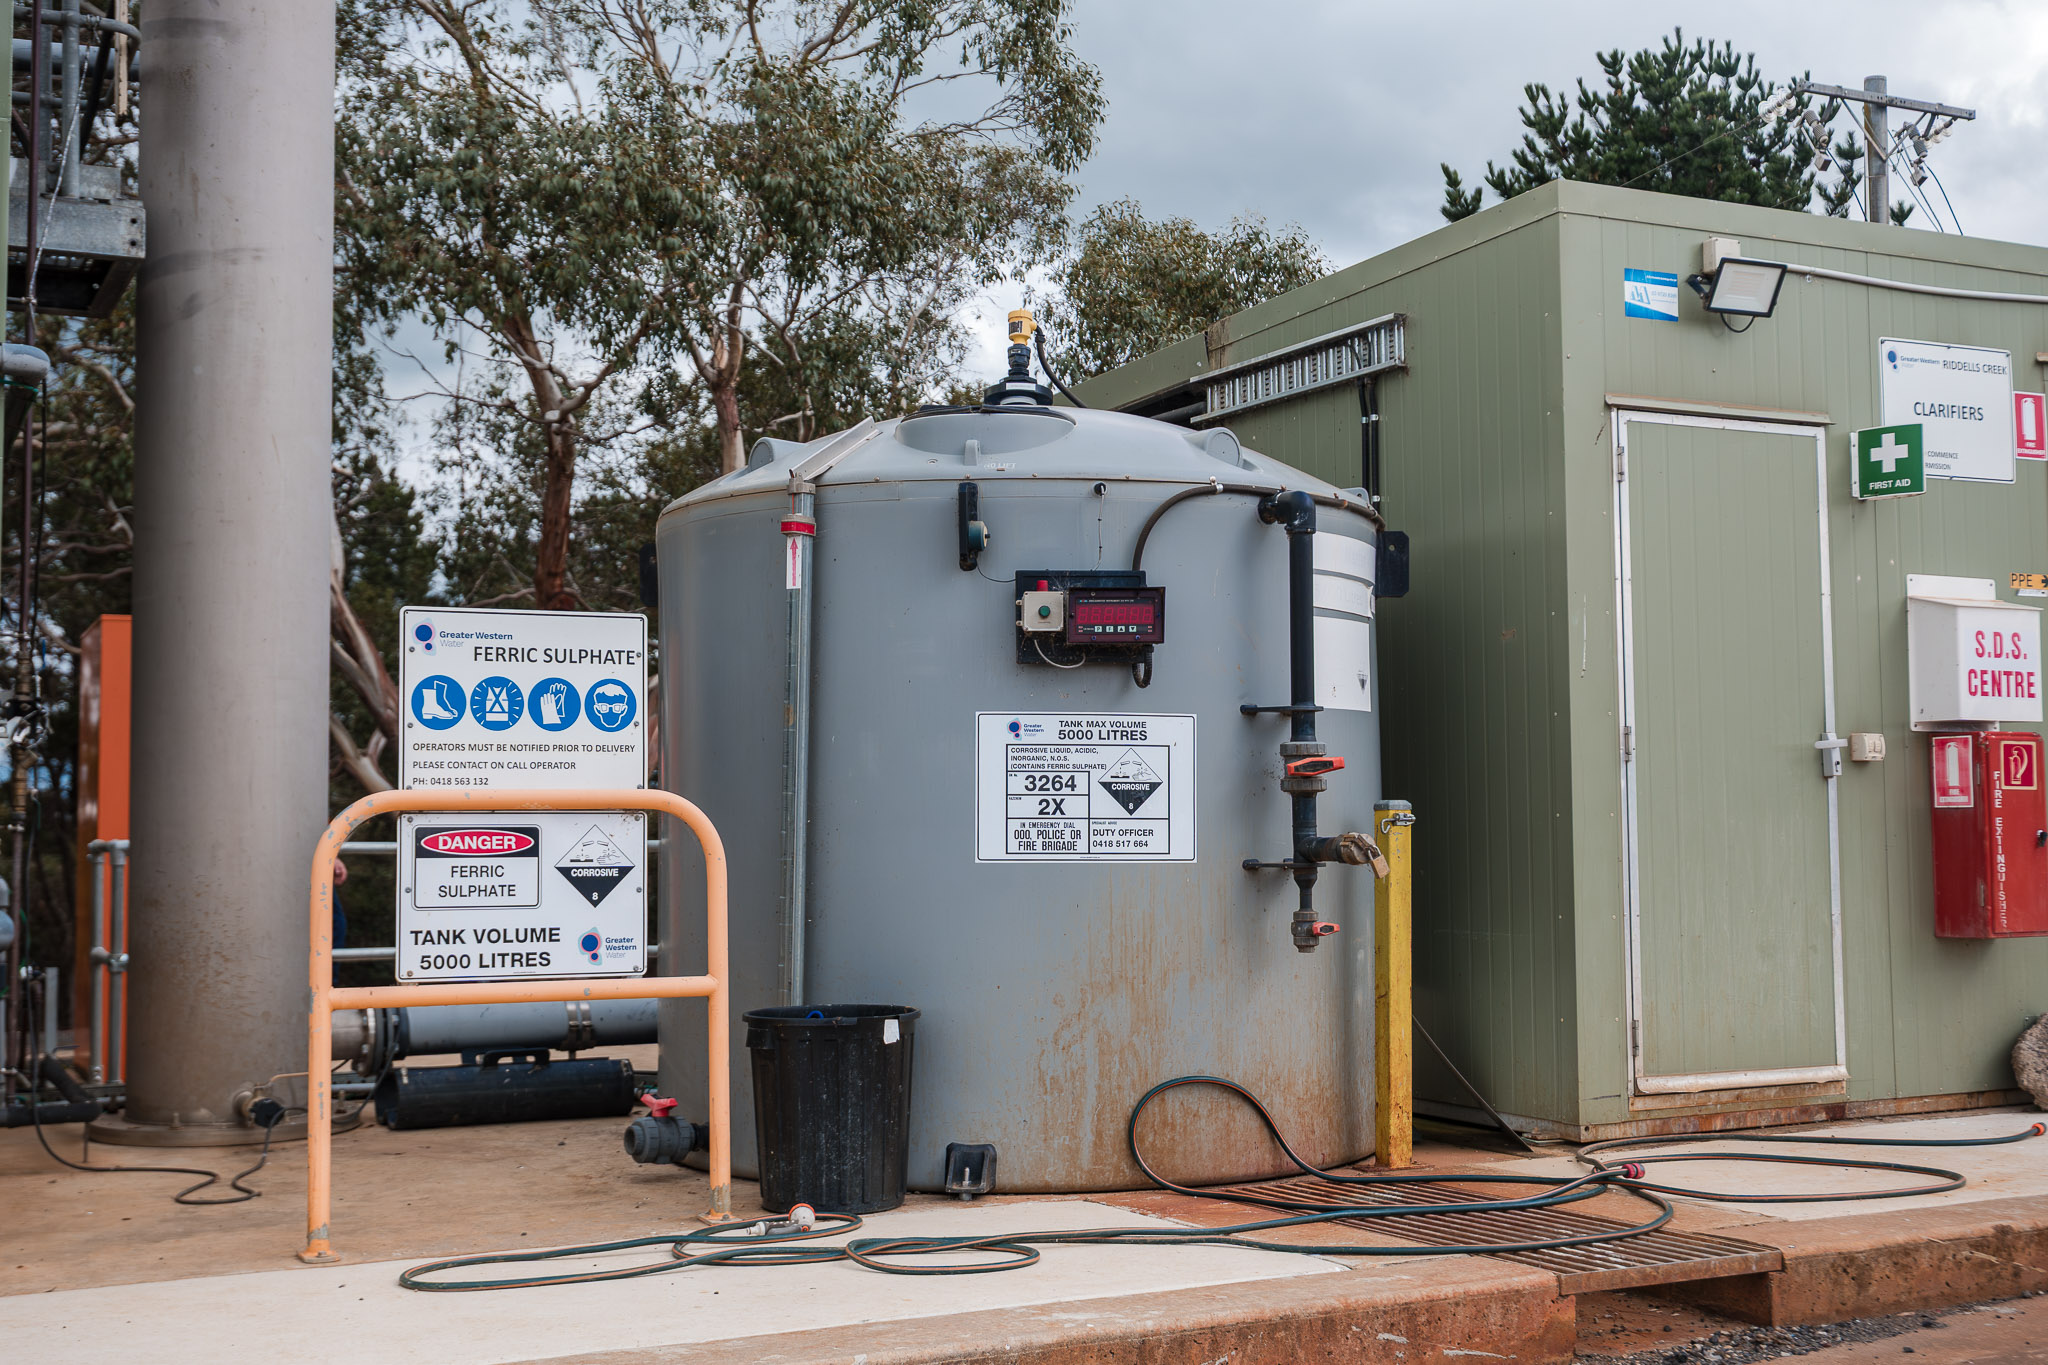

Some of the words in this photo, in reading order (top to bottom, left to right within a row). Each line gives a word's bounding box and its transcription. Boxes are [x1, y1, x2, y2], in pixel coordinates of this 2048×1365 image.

[1943, 360, 1980, 372] RIDDELLS
[1983, 364, 2007, 375] CREEK
[1913, 401, 1984, 421] CLARIFIERS
[1928, 451, 1959, 459] COMMENCE
[1869, 480, 1893, 490] FIRST
[1895, 479, 1911, 487] AID
[2011, 573, 2033, 587] PPE
[439, 631, 474, 639] Greater
[475, 632, 513, 640] Western
[1975, 630, 2027, 660] S.D.S.
[474, 646, 538, 663] FERRIC
[543, 649, 635, 665] SULPHATE
[1968, 669, 2036, 698] CENTRE
[1058, 730, 1093, 740] 5000
[1098, 730, 1148, 740] LITRES
[412, 743, 466, 751] OPERATORS
[468, 743, 493, 751] MUST
[510, 744, 550, 752] NOTIFIED
[552, 744, 579, 752] PRIOR
[581, 744, 593, 752] TO
[595, 744, 635, 752] DELIVERY
[412, 761, 445, 769] PLEASE
[447, 761, 488, 769] CONTACT
[490, 761, 504, 769] ON
[529, 762, 576, 770] OPERATOR
[430, 778, 452, 786] 0418
[454, 778, 471, 786] 563
[473, 778, 489, 786] 132
[1024, 775, 1077, 791] 3264
[1993, 771, 2003, 808] FIRE
[1038, 798, 1066, 816] 2X
[1037, 830, 1065, 839] POLICE
[1071, 830, 1081, 839] OR
[1118, 829, 1154, 837] OFFICER
[438, 836, 517, 850] DANGER
[1018, 841, 1037, 850] FIRE
[1042, 841, 1077, 850] BRIGADE
[1093, 840, 1114, 848] 0418
[1116, 840, 1131, 848] 517
[1133, 840, 1148, 848] 664
[451, 865, 505, 878] FERRIC
[571, 868, 619, 877] CORROSIVE
[438, 885, 516, 898] SULPHATE
[592, 892, 598, 900] 8
[410, 929, 466, 946] TANK
[473, 927, 560, 945] VOLUME
[420, 954, 471, 970] 5000
[479, 952, 551, 969] LITRES
